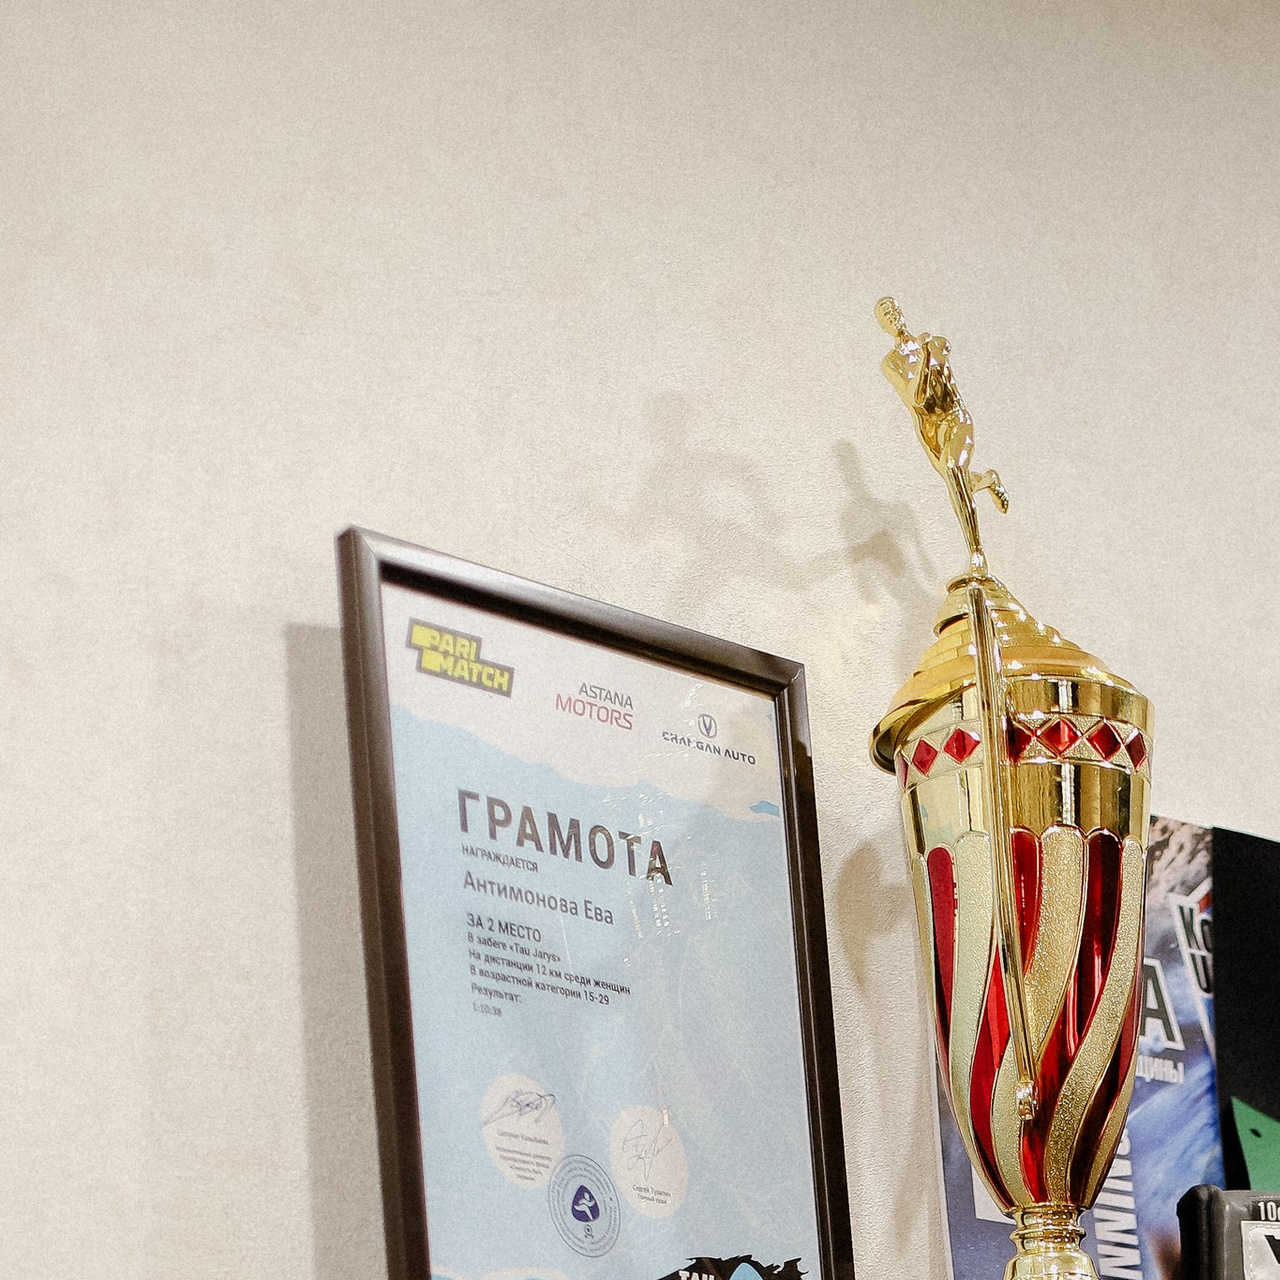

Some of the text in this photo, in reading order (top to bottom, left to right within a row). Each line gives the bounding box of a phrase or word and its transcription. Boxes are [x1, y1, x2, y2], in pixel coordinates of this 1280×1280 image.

[411, 624, 478, 661] PARI
[421, 652, 509, 691] MATCH
[556, 694, 633, 730] MOTORS
[579, 683, 633, 710] ASTANA
[724, 748, 756, 766] AUTO
[458, 788, 673, 886] ГРАМОТА
[461, 843, 539, 873] НАГРАЖДАЕТСЯ
[463, 870, 615, 925] Антимонова Ева
[466, 913, 541, 943] ЗА 2 МЕСТО
[477, 934, 507, 950] забеге
[469, 948, 631, 996] На дистанции 12 км среди женщин
[479, 968, 533, 989] возрастной
[535, 982, 581, 1000] категории
[584, 990, 610, 1006] 15-29
